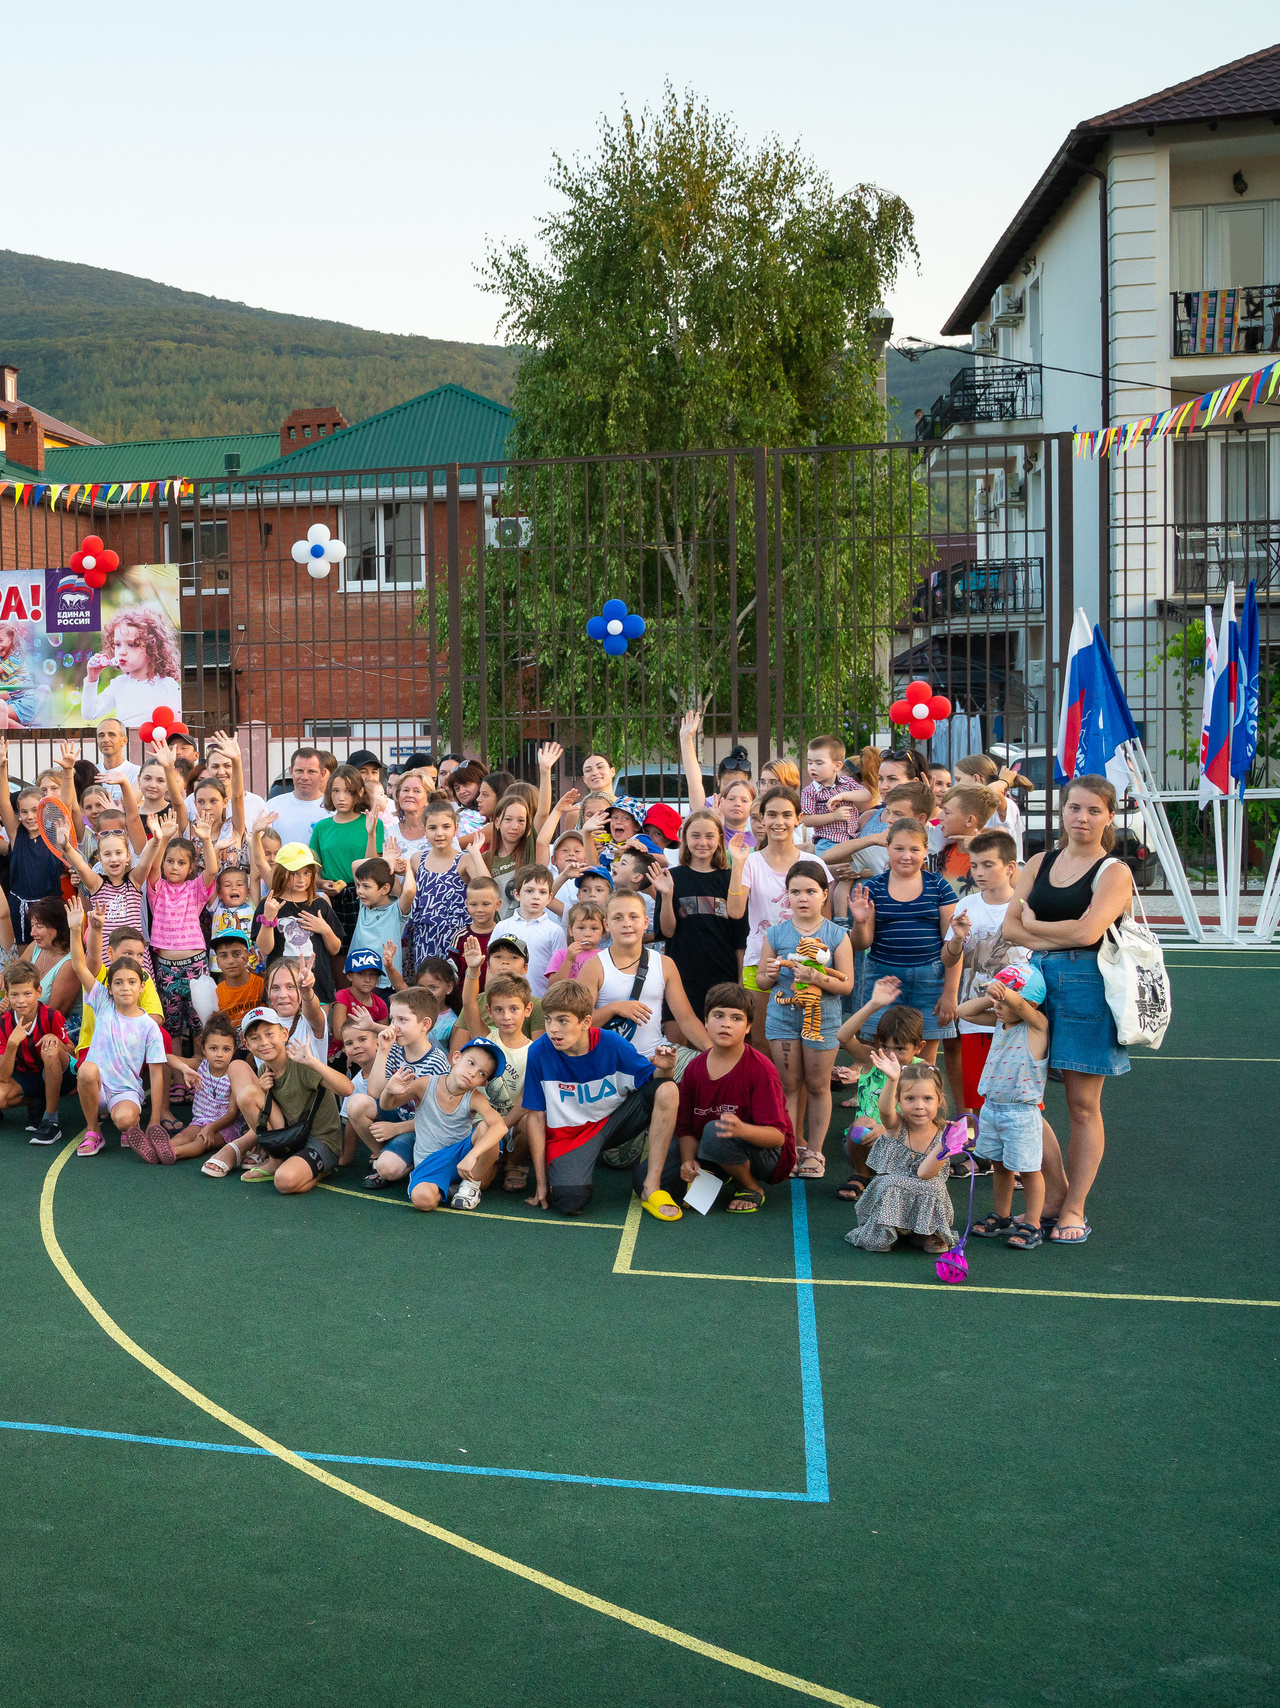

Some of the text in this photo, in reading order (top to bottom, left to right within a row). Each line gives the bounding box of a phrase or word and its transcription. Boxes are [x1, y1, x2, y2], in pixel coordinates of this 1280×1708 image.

[57, 610, 91, 618] ЕДИНАЯ
[57, 618, 91, 626] РОССИЯ
[172, 958, 191, 966] VIBES
[505, 1062, 520, 1081] ONS
[559, 1078, 617, 1105] FILA
